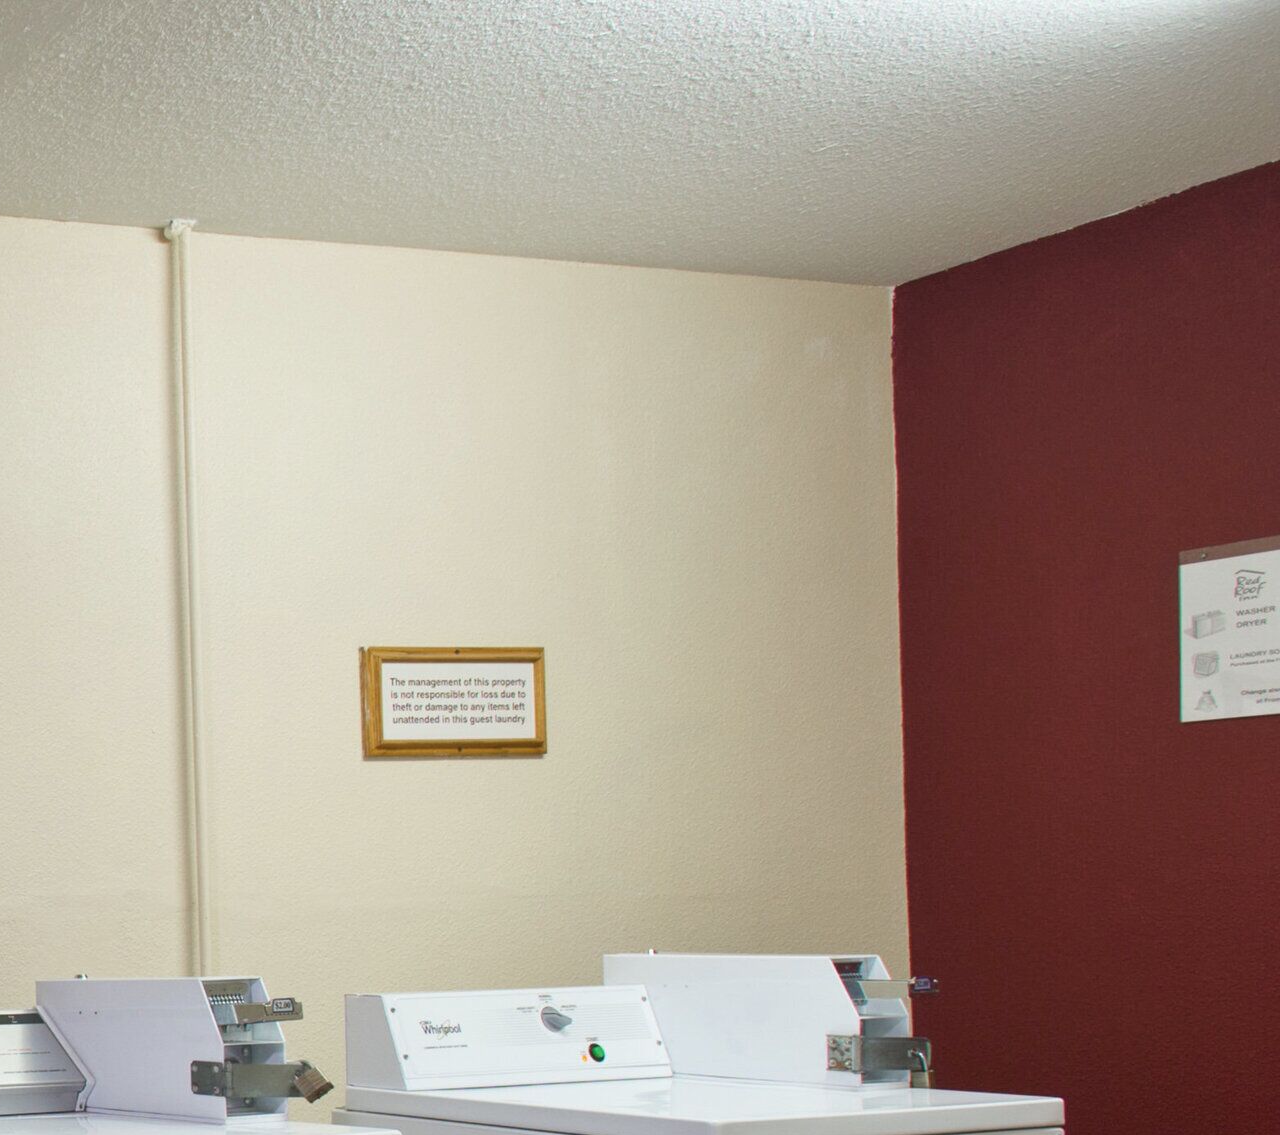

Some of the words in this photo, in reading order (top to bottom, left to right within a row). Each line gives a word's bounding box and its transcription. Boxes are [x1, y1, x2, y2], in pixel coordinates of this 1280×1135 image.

[1236, 575, 1261, 586] Red
[1234, 581, 1267, 598] Roof
[1235, 605, 1276, 616] WASHER
[1235, 619, 1268, 629] DRYER
[390, 677, 406, 687] The
[407, 678, 461, 688] management
[463, 677, 472, 686] of
[474, 677, 489, 686] this
[491, 678, 526, 688] property
[390, 690, 398, 699] is
[400, 690, 415, 699] not
[416, 690, 465, 701] responsible
[467, 690, 479, 698] for
[481, 690, 498, 699] loss
[500, 690, 516, 698] due
[518, 690, 526, 698] to
[392, 702, 412, 711] theft
[425, 702, 458, 713] damage
[460, 703, 468, 711] to
[470, 704, 485, 712] any
[487, 702, 510, 711] items
[512, 702, 525, 711] left
[392, 715, 440, 724] unattended
[442, 715, 450, 723] in
[452, 715, 468, 723] this
[469, 716, 493, 725] guest
[494, 714, 526, 725] laundry
[421, 1021, 462, 1038] Whirlpool
